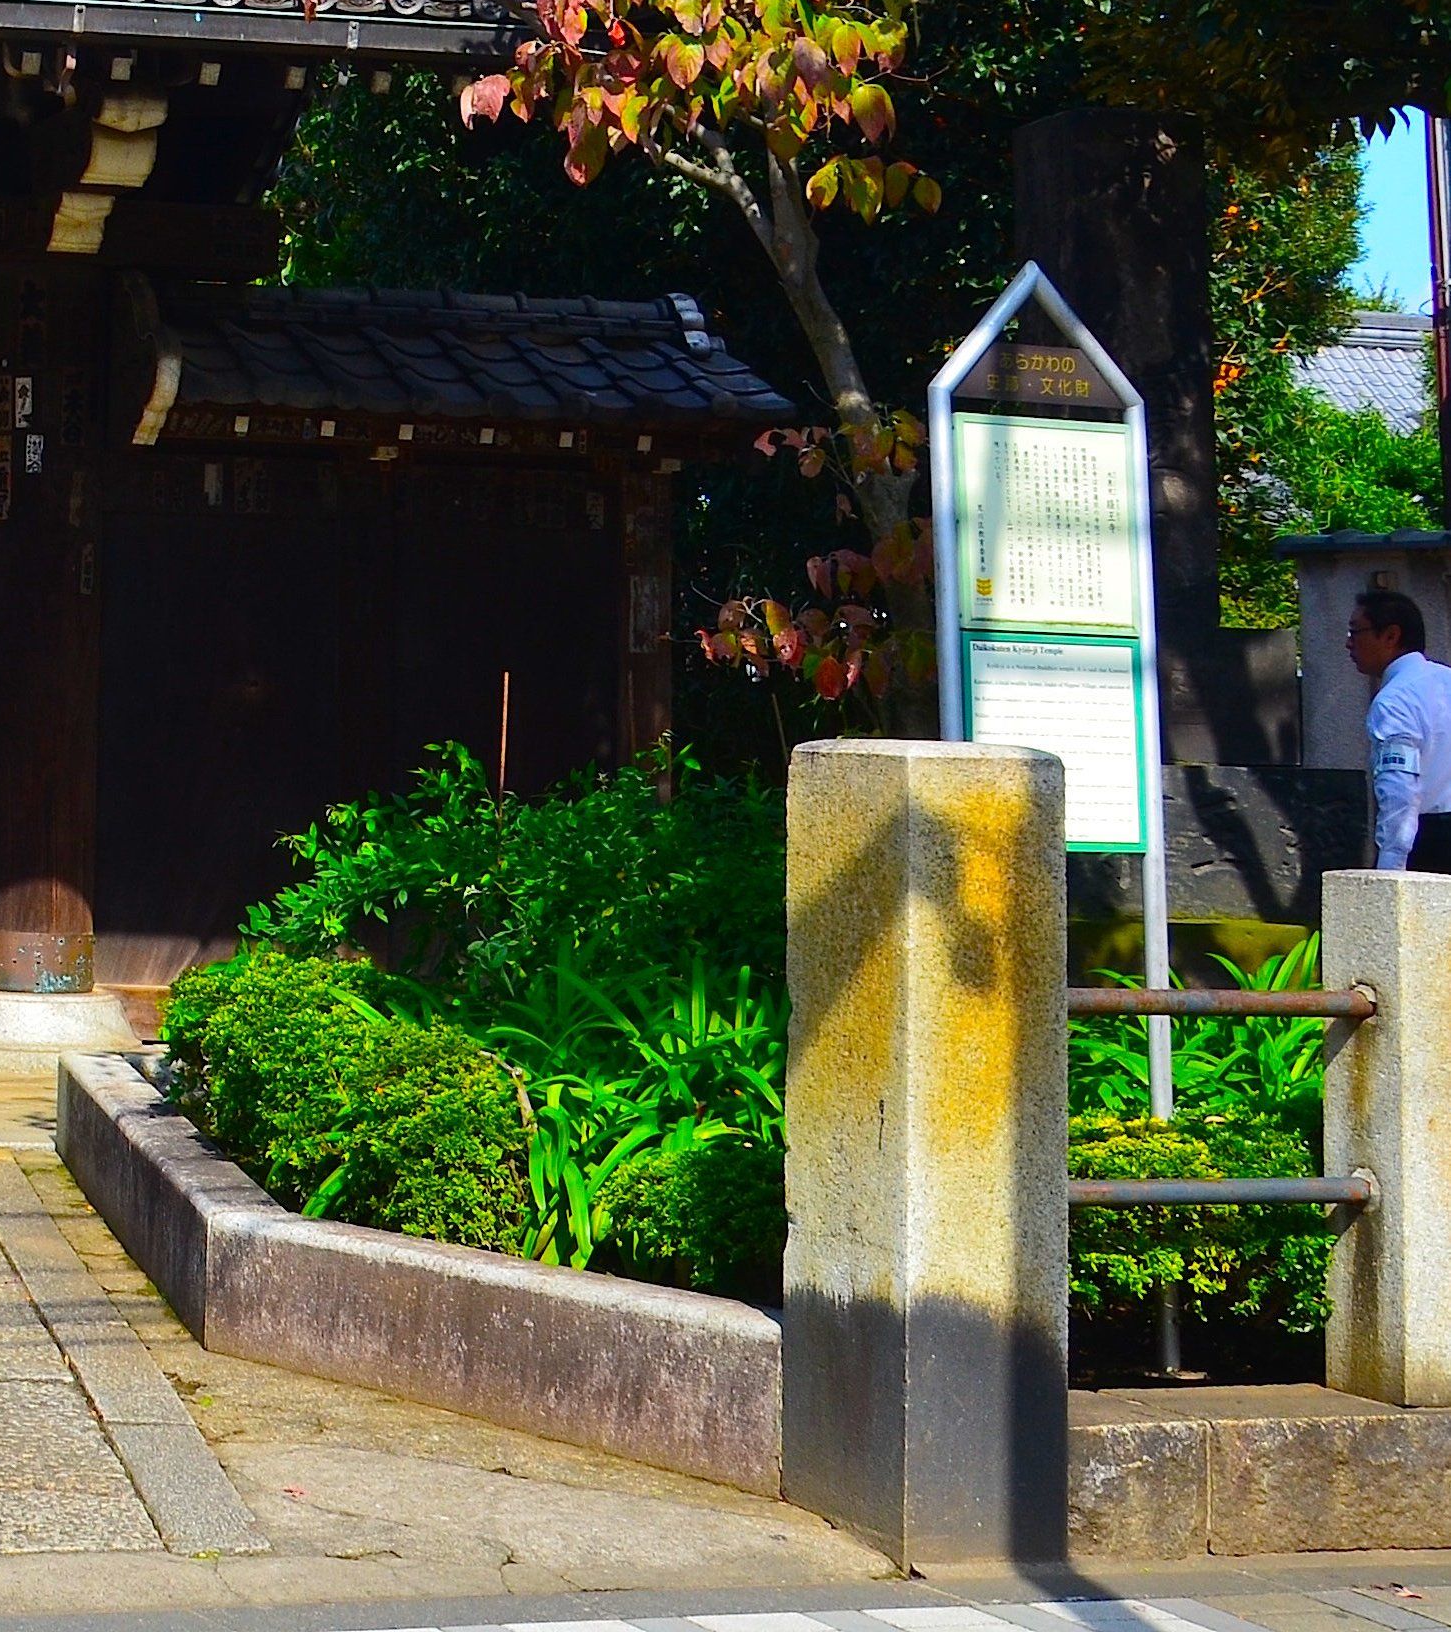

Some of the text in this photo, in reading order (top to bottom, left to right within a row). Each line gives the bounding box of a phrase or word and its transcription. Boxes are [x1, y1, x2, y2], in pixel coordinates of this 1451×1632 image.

[999, 351, 1076, 374] あらかわの
[1040, 646, 1064, 656] Temple
